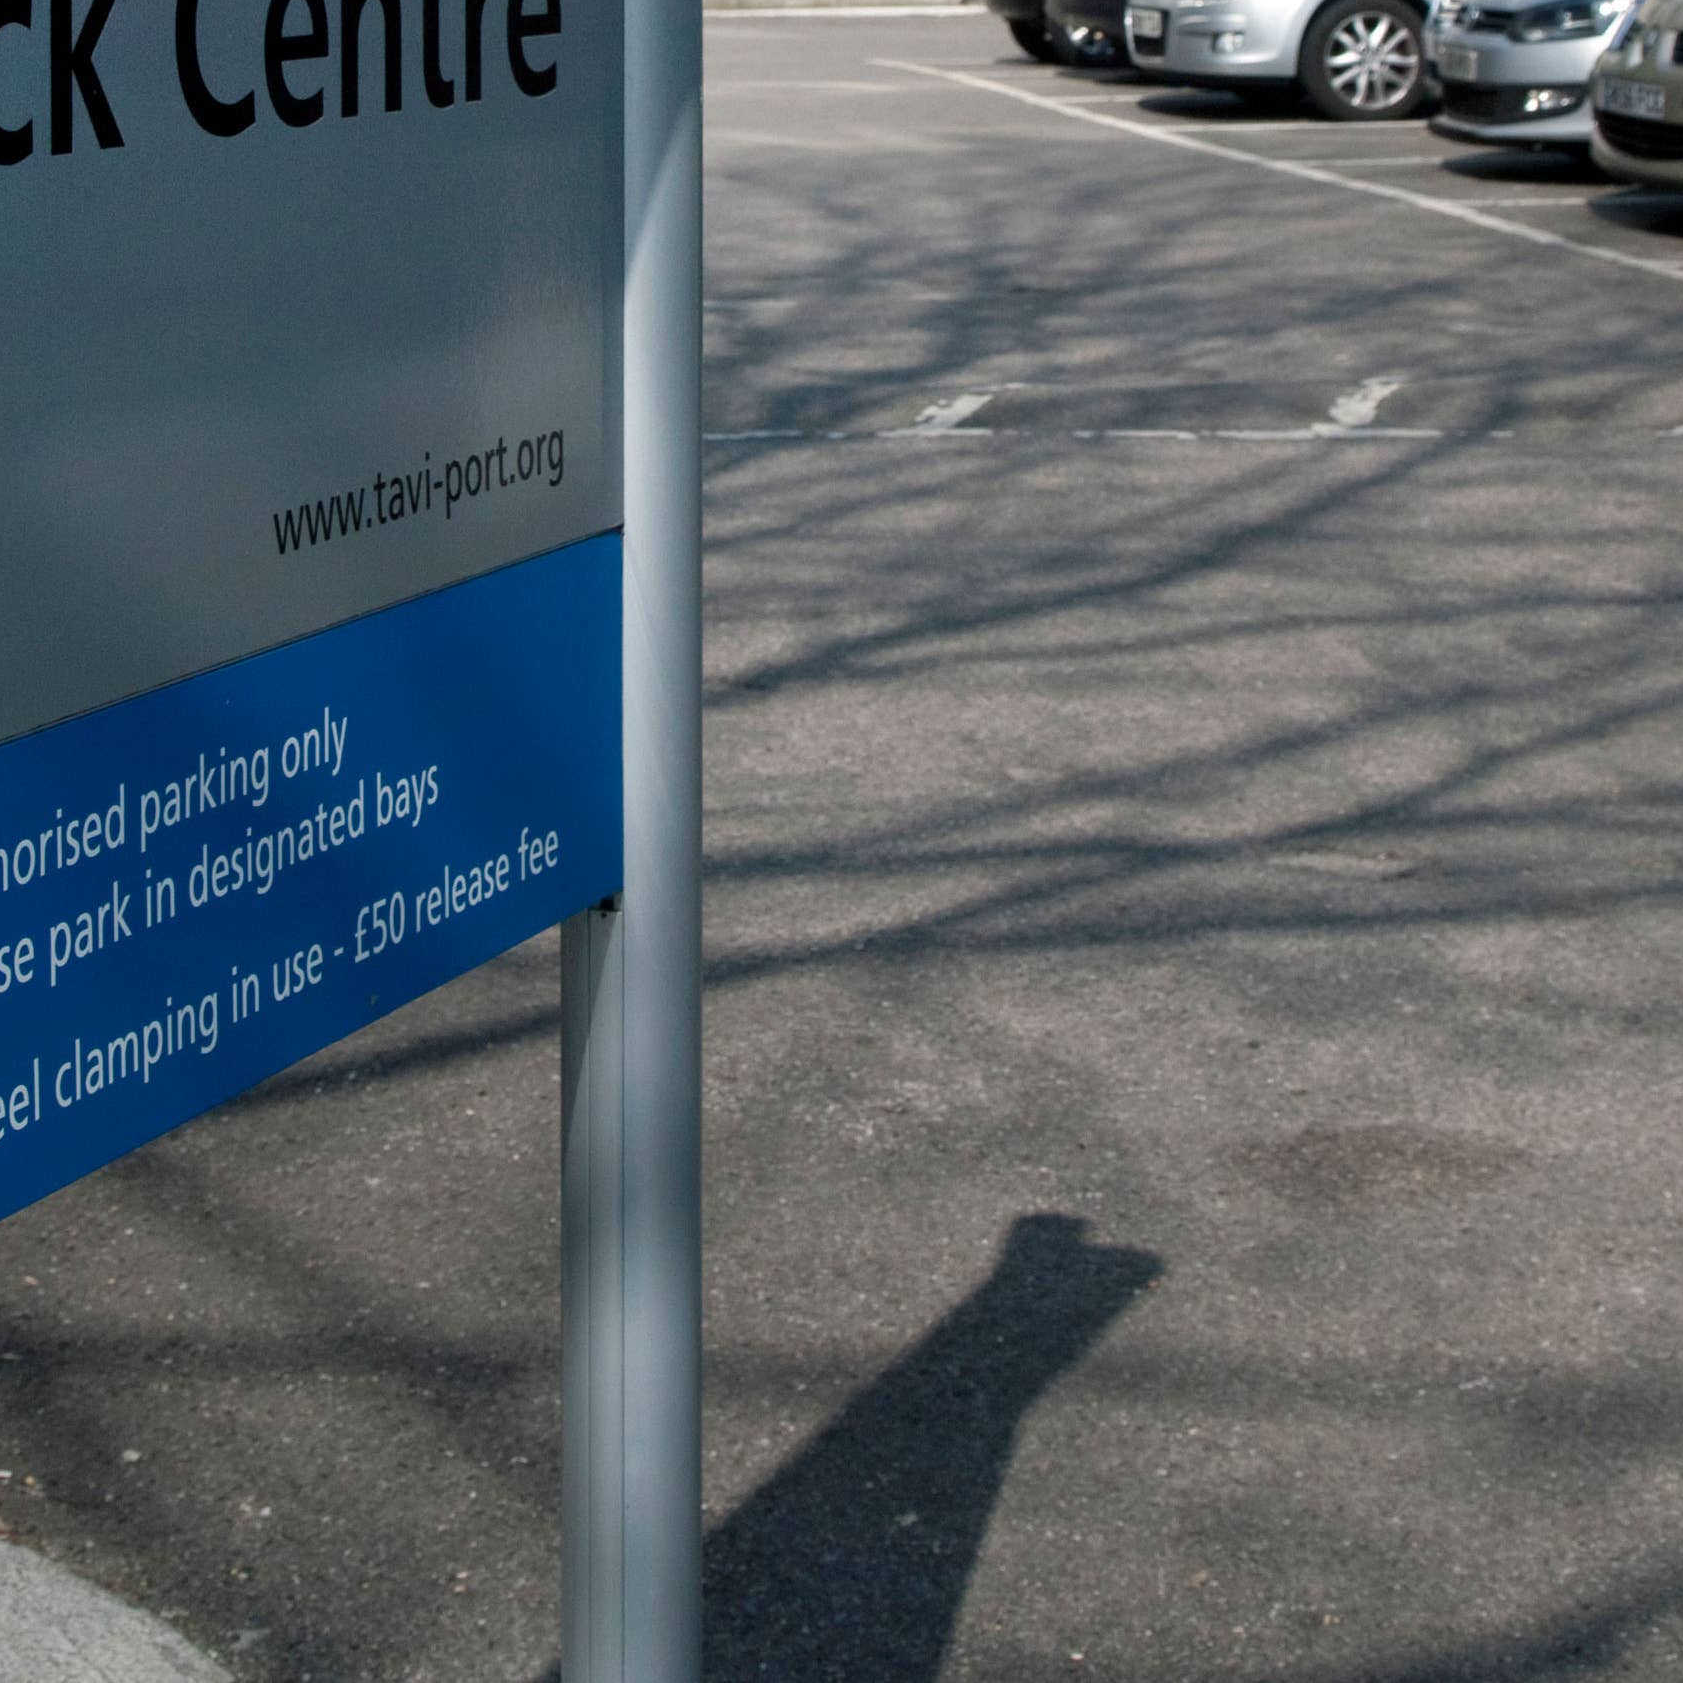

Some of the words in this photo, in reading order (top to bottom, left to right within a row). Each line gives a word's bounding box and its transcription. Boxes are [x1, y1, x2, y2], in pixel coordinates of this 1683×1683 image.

[273, 431, 563, 555] www.tavi-port.org
[141, 748, 269, 852] parking
[282, 707, 347, 778] only
[50, 881, 131, 987] park
[146, 878, 175, 927] in
[189, 779, 364, 907] designated
[377, 766, 438, 827] bays
[55, 993, 217, 1107] clamping
[232, 966, 259, 1022] in
[273, 944, 323, 1001] use
[355, 891, 405, 962] £50
[416, 854, 509, 932] release
[518, 827, 558, 880] fee
